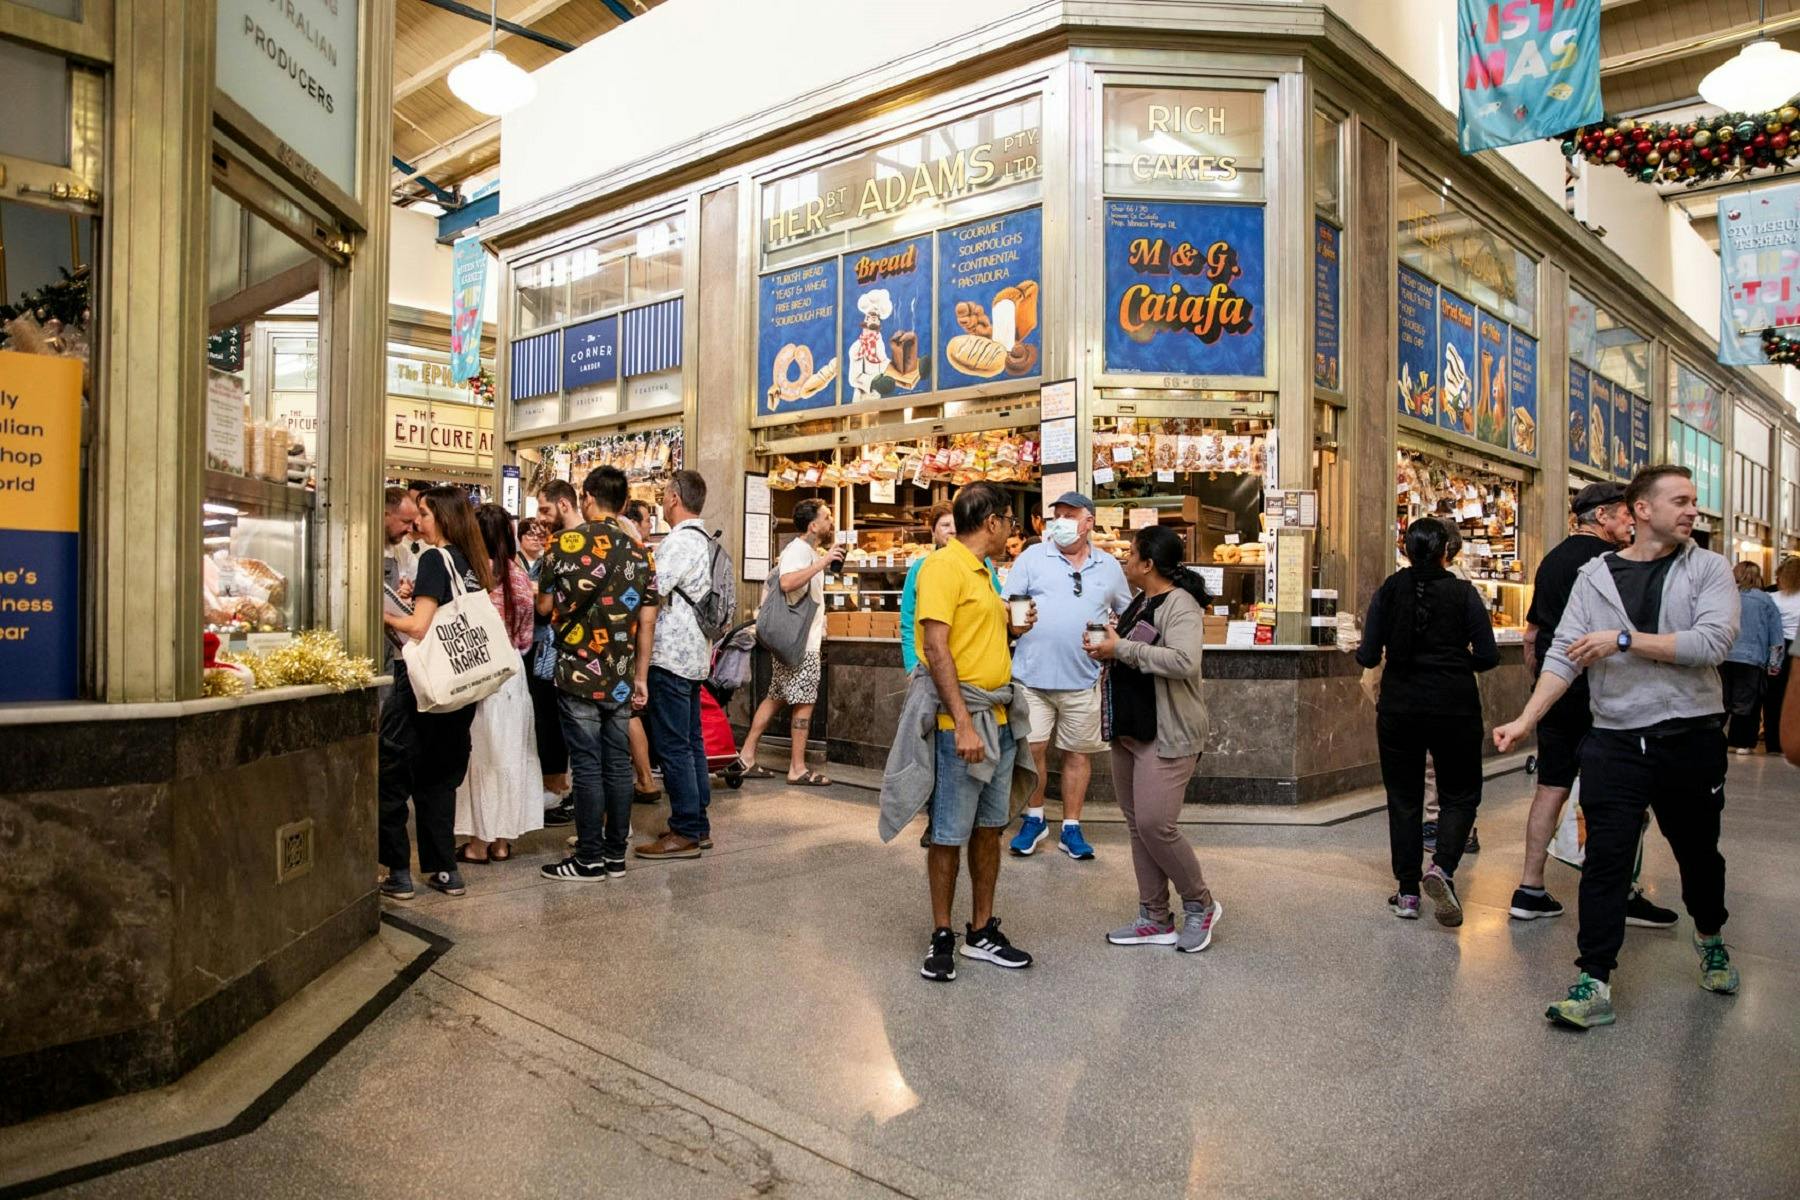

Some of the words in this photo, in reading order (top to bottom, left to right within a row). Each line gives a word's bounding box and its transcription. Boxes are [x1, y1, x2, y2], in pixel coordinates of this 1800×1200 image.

[243, 14, 335, 114] PRODUCERS
[1465, 28, 1578, 91] MAS
[1148, 104, 1226, 135] RICH
[858, 144, 996, 217] ADAMS
[1131, 154, 1238, 182] CAKES
[958, 232, 1023, 256] SOURDOUGHS
[959, 220, 1006, 241] GOURMET
[855, 243, 917, 282] Bread
[958, 250, 1020, 273] CONTINENTAL
[1128, 238, 1164, 267] M
[1171, 242, 1199, 267] &
[1206, 241, 1242, 278] G.
[958, 268, 1010, 289] PASTADURA
[775, 287, 795, 301] YEAST
[775, 309, 815, 328] SOURDOUGH
[1119, 282, 1247, 337] Caiafa
[570, 345, 613, 364] CORNER
[0, 418, 44, 437] lian
[413, 409, 437, 424] THE
[395, 422, 494, 451] EPICUREA
[0, 567, 37, 585] e's
[0, 598, 54, 612] ness
[435, 611, 470, 641] QUEEN
[443, 625, 490, 658] VICTORIA
[449, 643, 492, 675] MARKET
